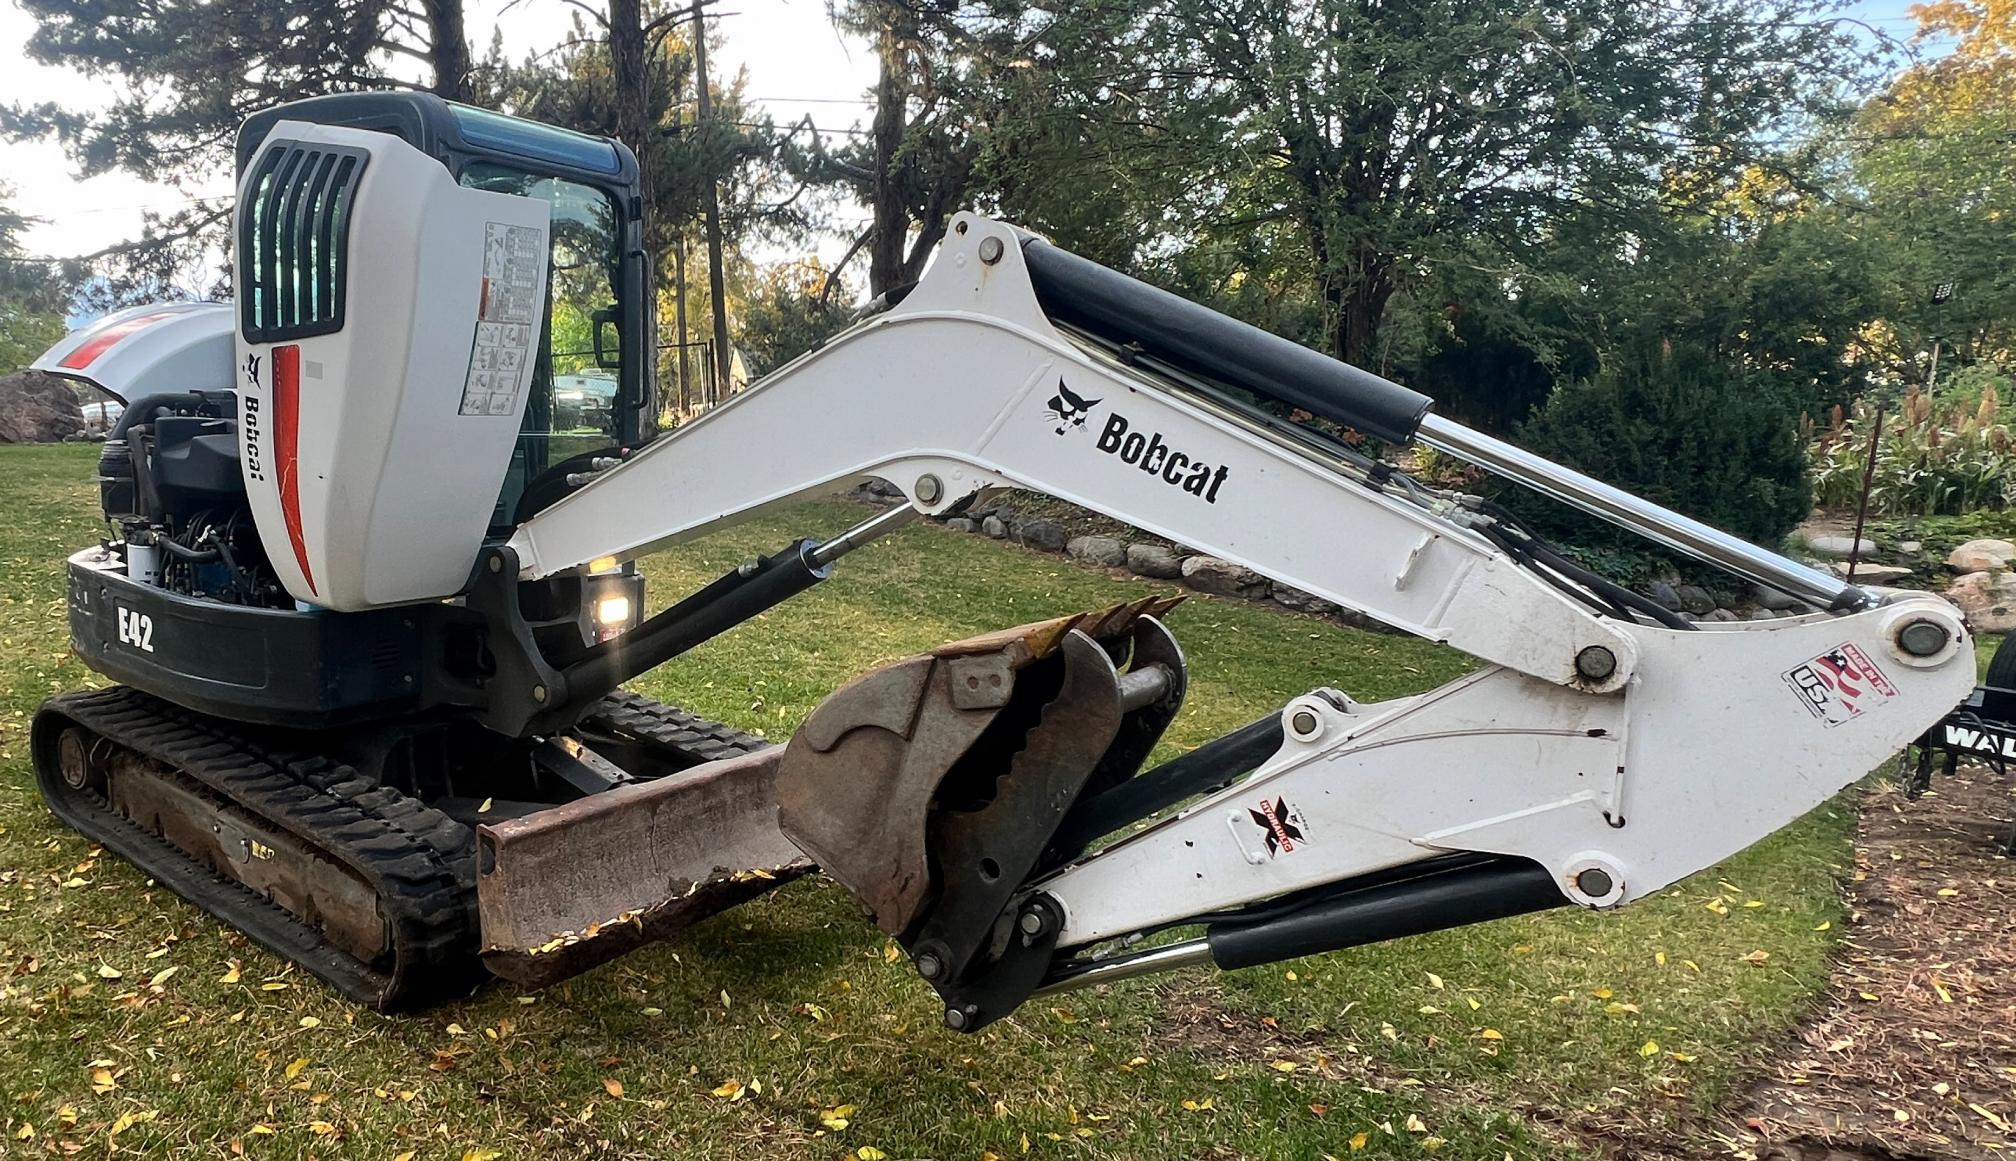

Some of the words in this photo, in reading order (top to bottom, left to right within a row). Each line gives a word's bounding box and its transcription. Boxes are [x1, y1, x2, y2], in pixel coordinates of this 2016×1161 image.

[1096, 412, 1229, 504] Bobcat
[117, 606, 154, 653] E42
[1843, 644, 1869, 671] MADE
[1863, 667, 1877, 681] IN
[1260, 800, 1292, 852] HYDRAULIC
